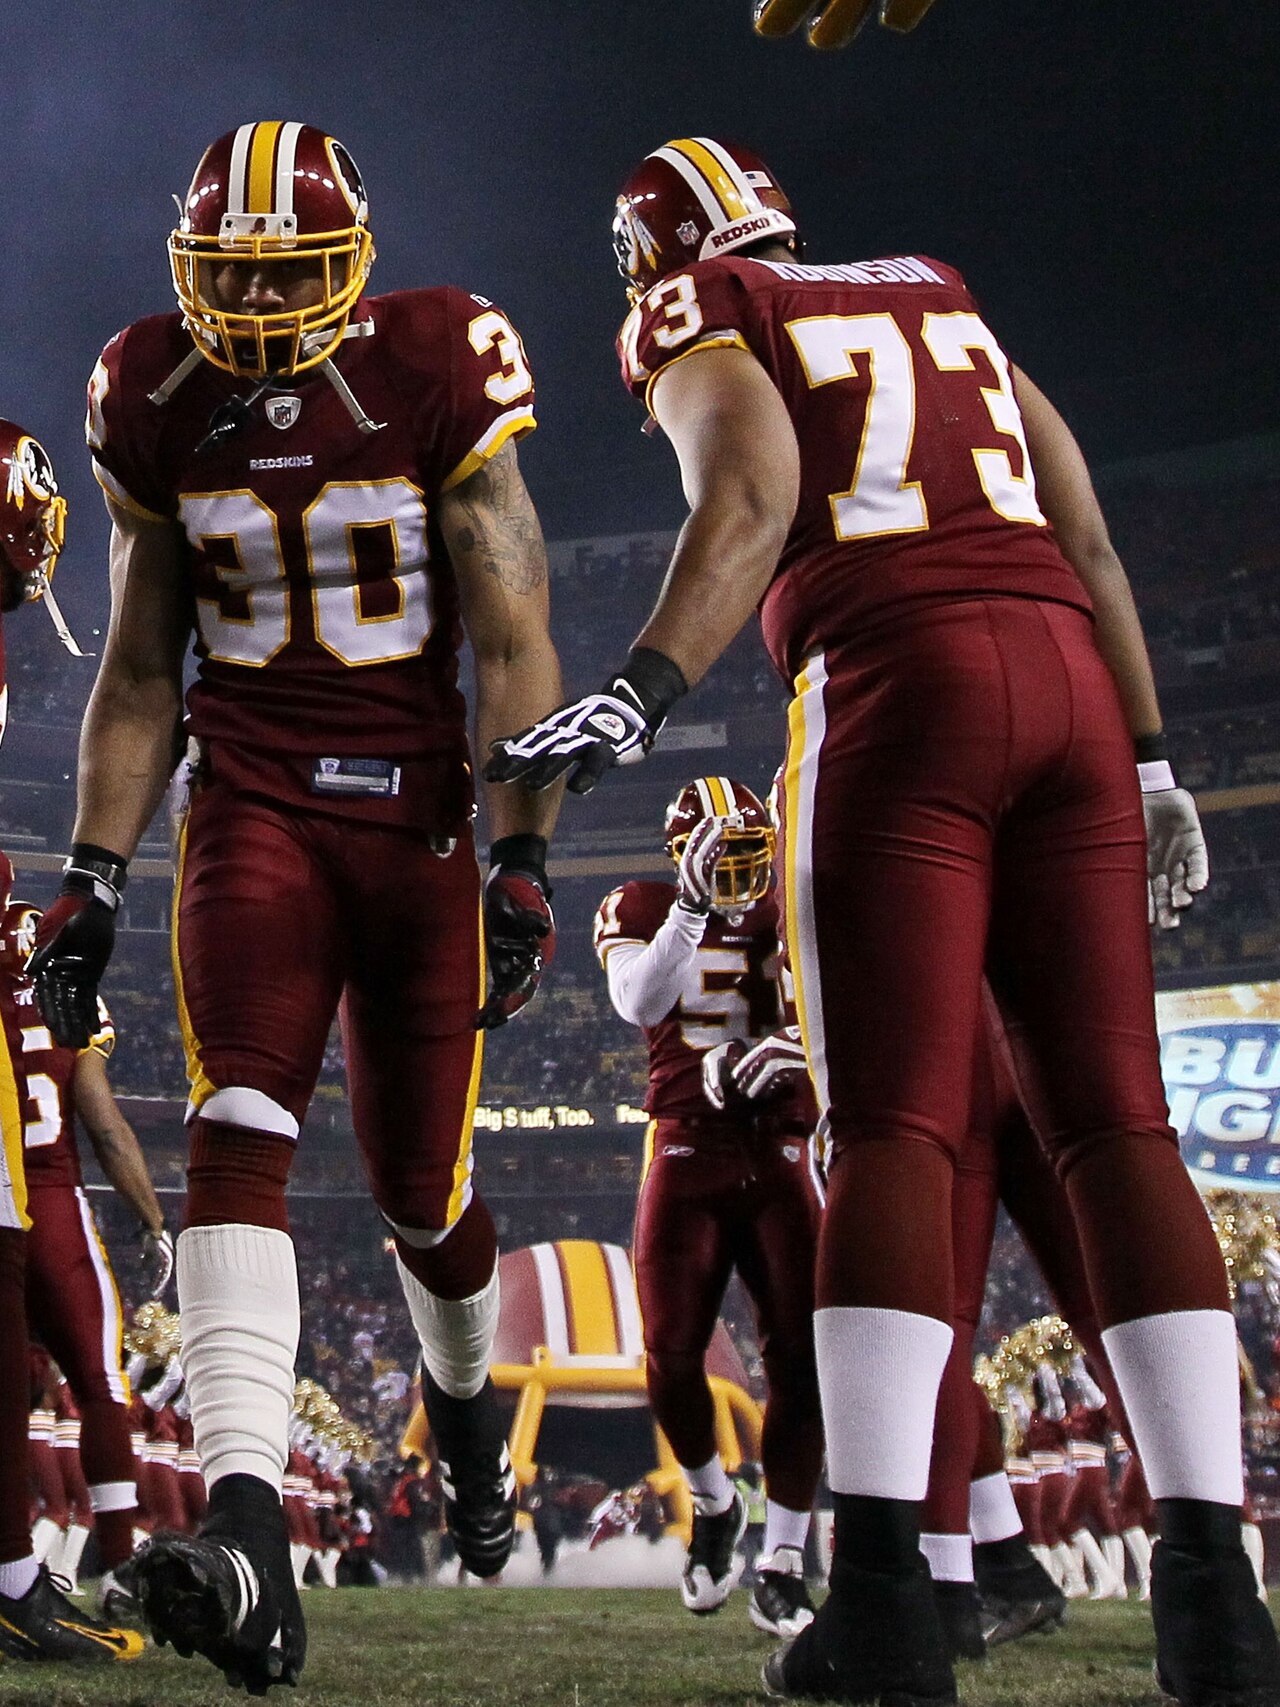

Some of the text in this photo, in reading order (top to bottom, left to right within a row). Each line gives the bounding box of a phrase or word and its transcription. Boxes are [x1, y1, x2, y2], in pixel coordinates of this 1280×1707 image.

[467, 311, 535, 406] 3
[249, 454, 314, 471] REDSKINS
[784, 310, 1048, 542] 73
[177, 476, 433, 668] 30
[680, 948, 775, 1050] 5
